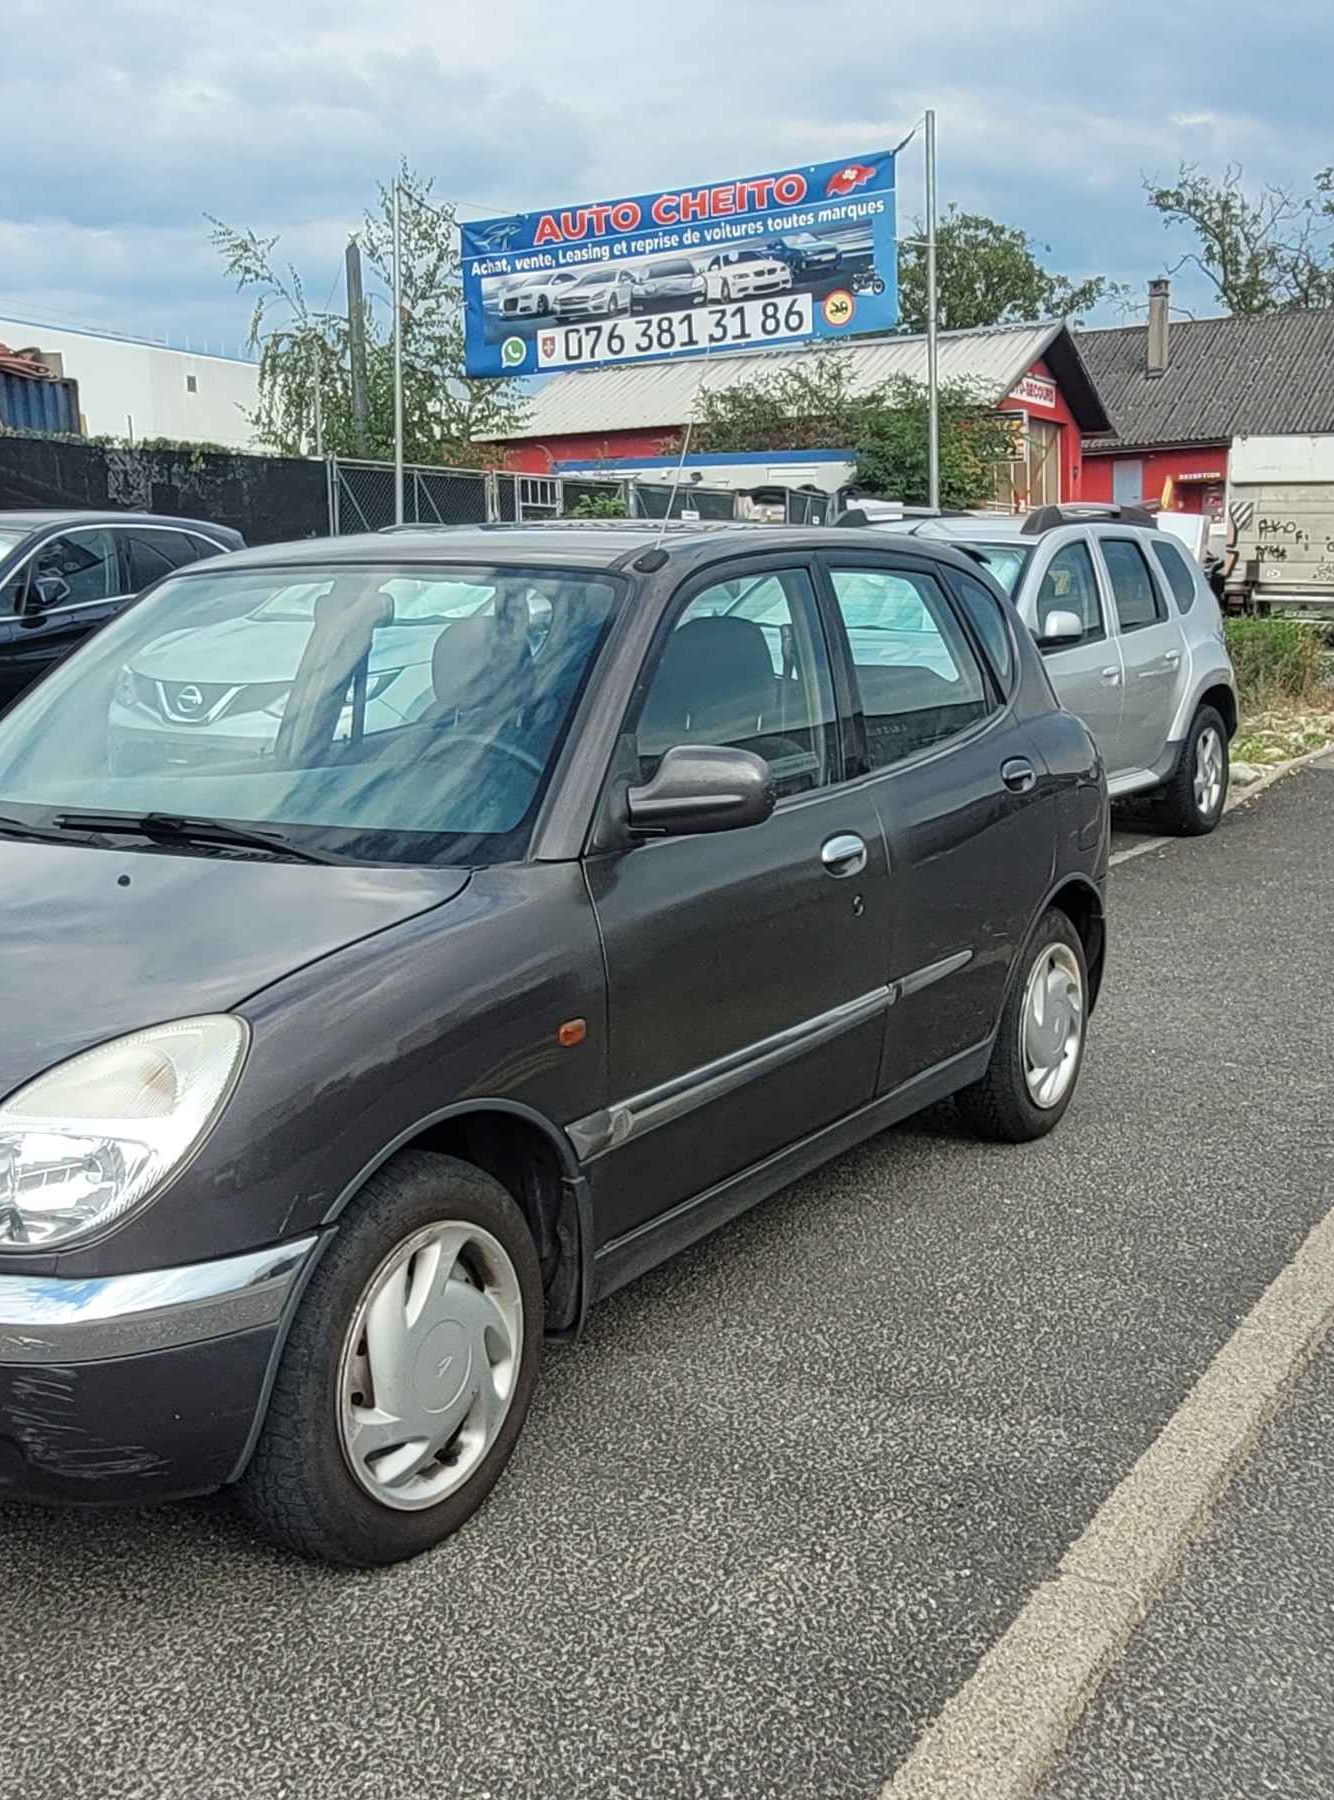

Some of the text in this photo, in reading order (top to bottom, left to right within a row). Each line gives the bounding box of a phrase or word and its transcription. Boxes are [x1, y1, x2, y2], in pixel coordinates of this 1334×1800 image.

[471, 199, 885, 277] Achat, vente, Leasing et reprise de voitures toutes marques
[533, 173, 807, 246] AUTO CHEITO
[564, 298, 804, 361] 076 381 31 86
